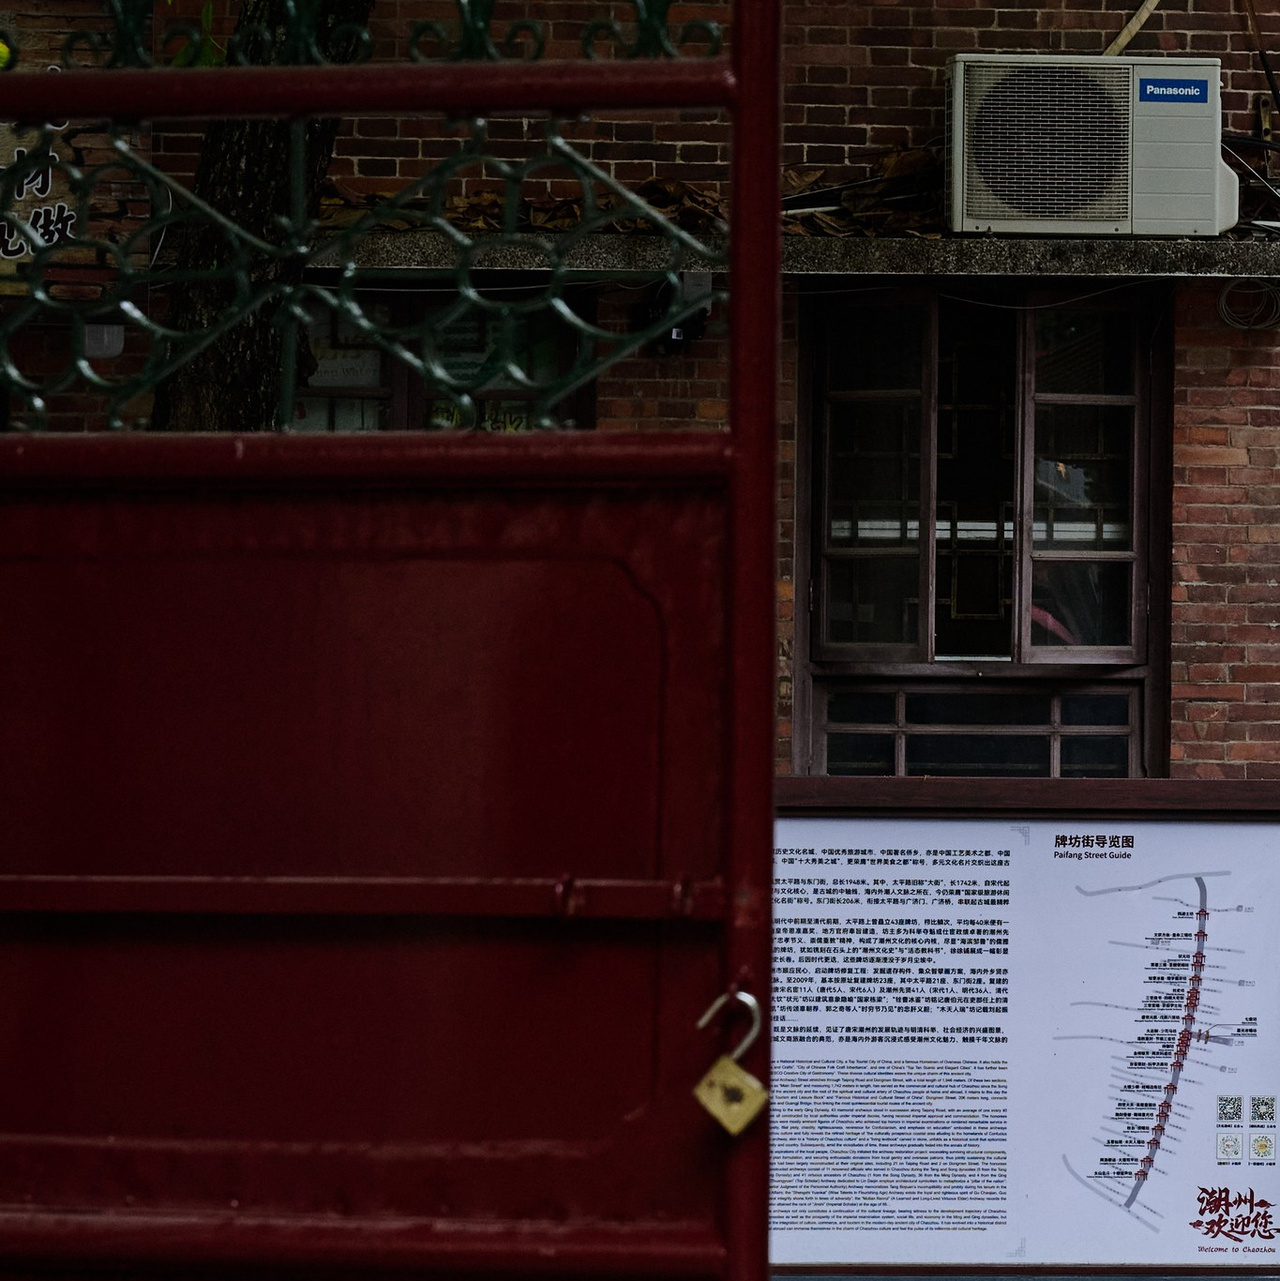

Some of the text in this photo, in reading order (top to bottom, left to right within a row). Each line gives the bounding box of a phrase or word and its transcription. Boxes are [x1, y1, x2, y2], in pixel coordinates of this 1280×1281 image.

[1146, 85, 1200, 95] Panasonic
[1054, 835, 1134, 848] 牌坊街导览图
[1054, 851, 1132, 860] Paifang Street Guide
[1196, 1185, 1255, 1216] 潮州
[1197, 1245, 1229, 1253] Welcome
[1242, 1245, 1276, 1253] Chaozhou
